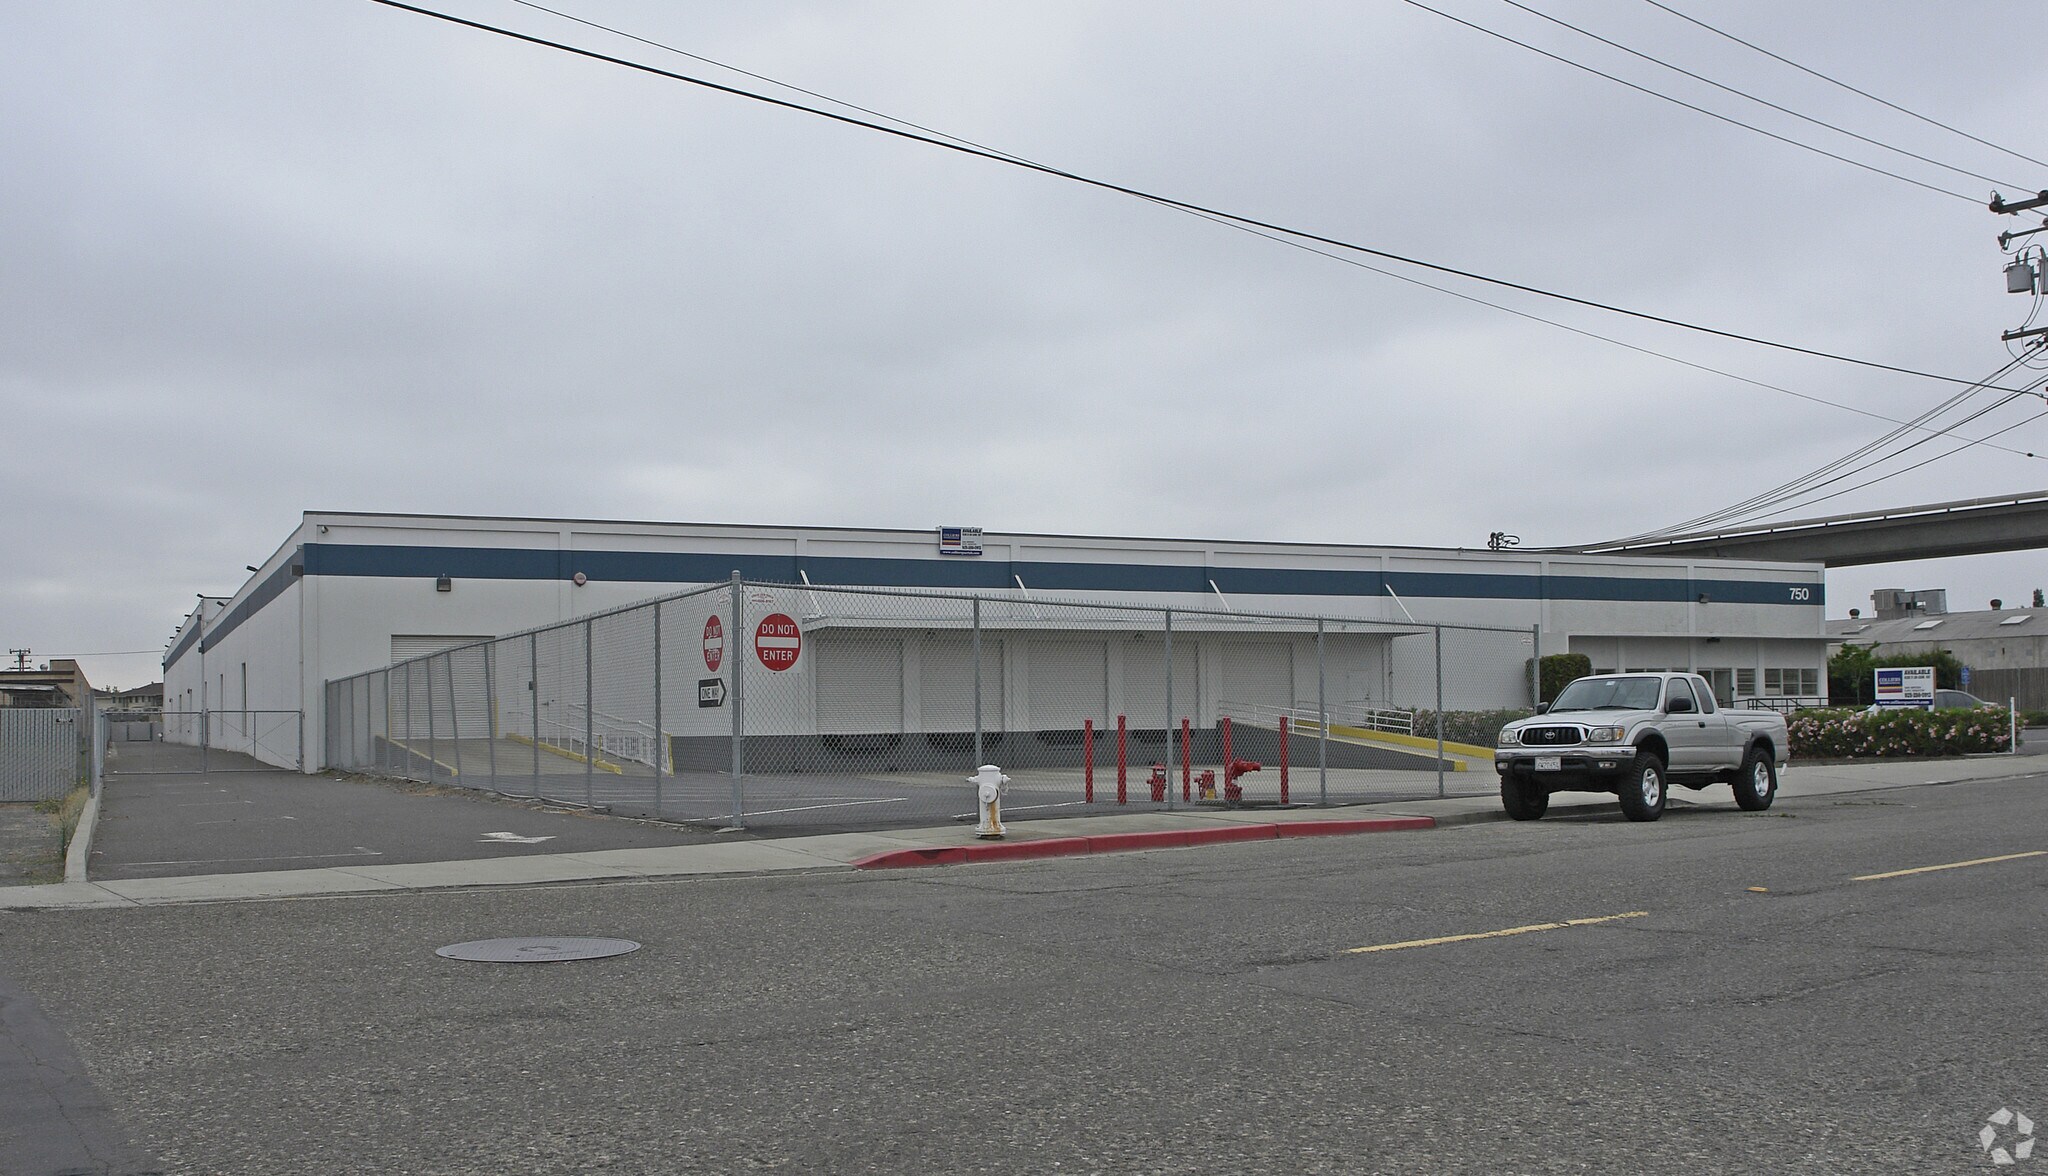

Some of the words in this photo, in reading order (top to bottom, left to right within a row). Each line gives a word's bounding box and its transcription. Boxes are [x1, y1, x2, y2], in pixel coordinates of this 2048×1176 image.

[1789, 588, 1809, 600] 750
[706, 626, 712, 636] DO
[761, 624, 775, 634] DO
[777, 624, 794, 635] NOT
[707, 650, 720, 661] ENTER
[763, 650, 793, 660] ENTER
[702, 688, 711, 699] ONE
